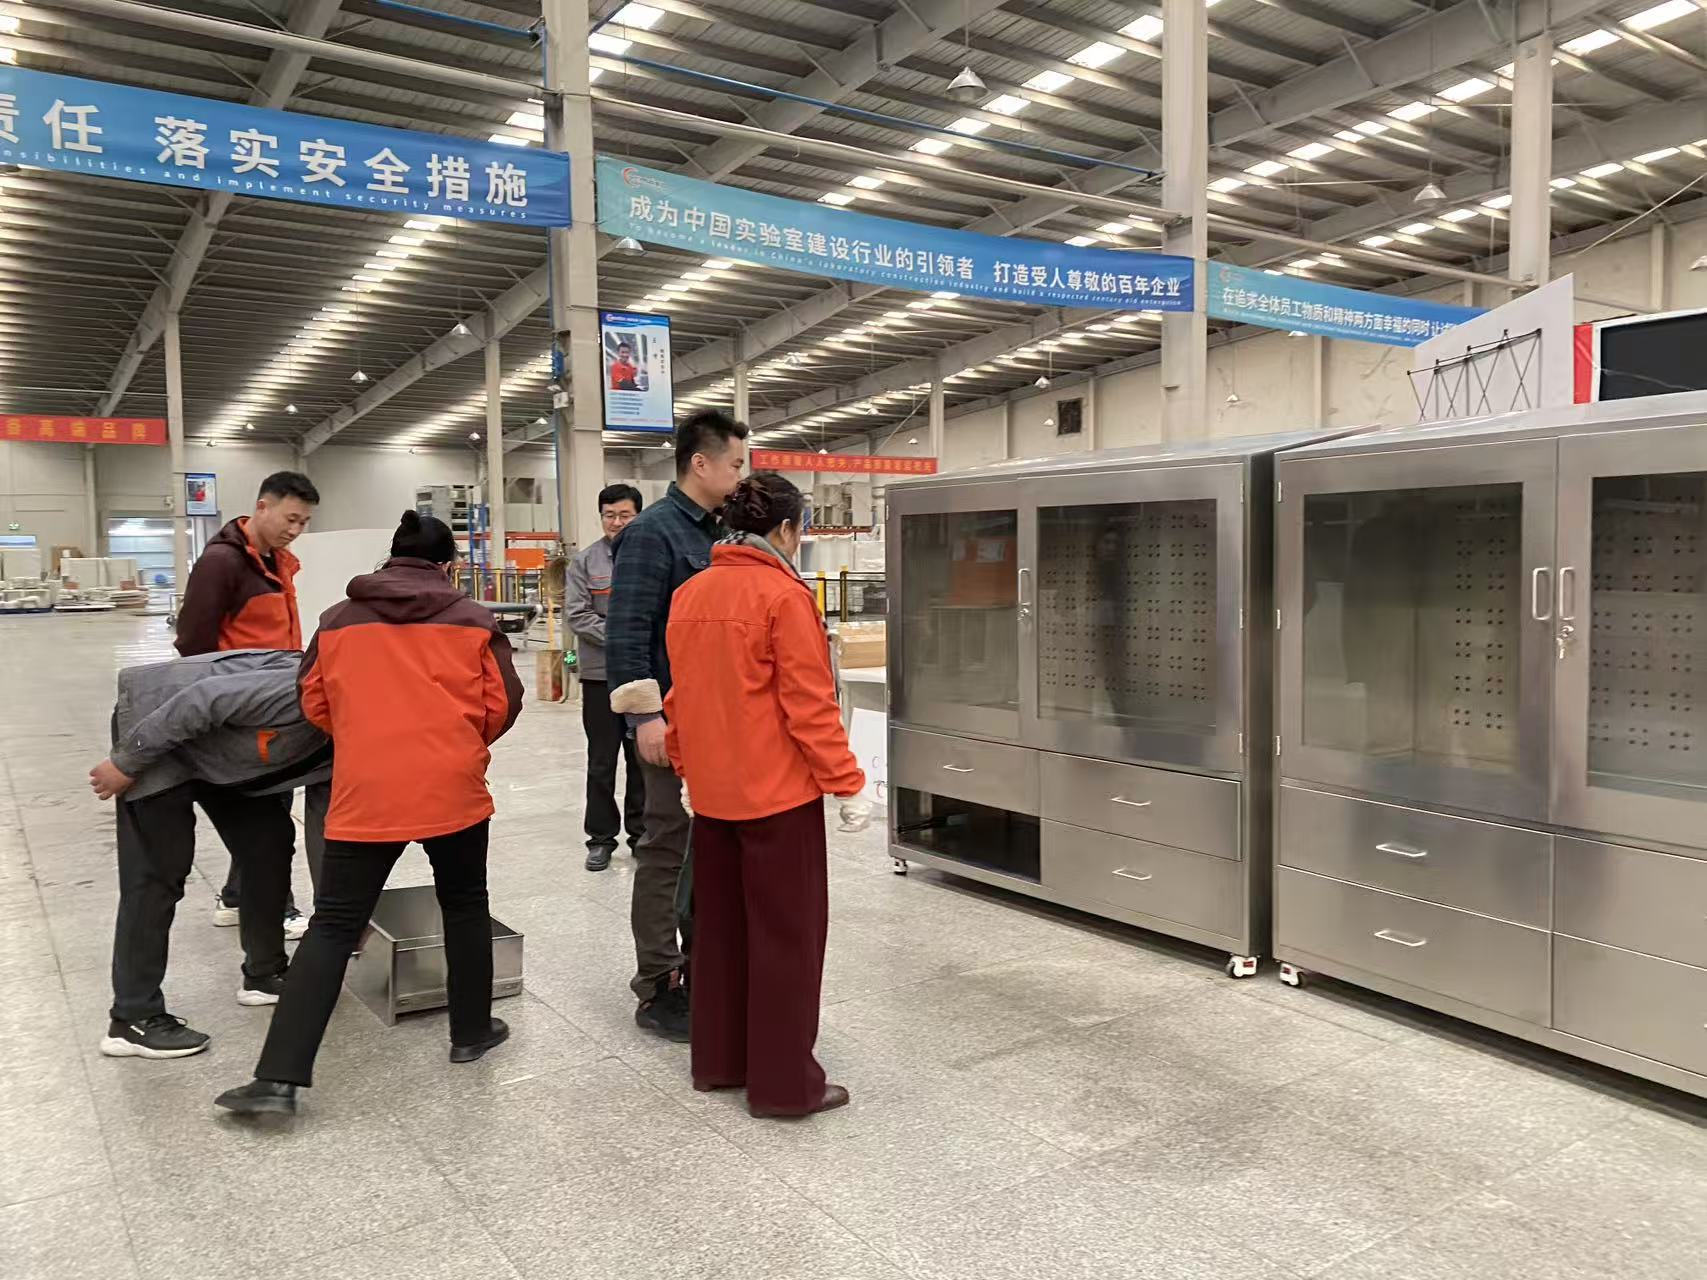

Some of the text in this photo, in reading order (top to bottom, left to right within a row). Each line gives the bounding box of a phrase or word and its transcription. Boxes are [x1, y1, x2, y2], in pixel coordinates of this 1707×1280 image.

[154, 116, 528, 207] 落实安全措施
[164, 170, 201, 182] and
[217, 176, 331, 198] implement
[345, 193, 430, 211] security
[443, 203, 527, 219] measures
[629, 194, 1181, 297] 成为中国实验室建设行业的引领者 打造受人尊敬的百年企业
